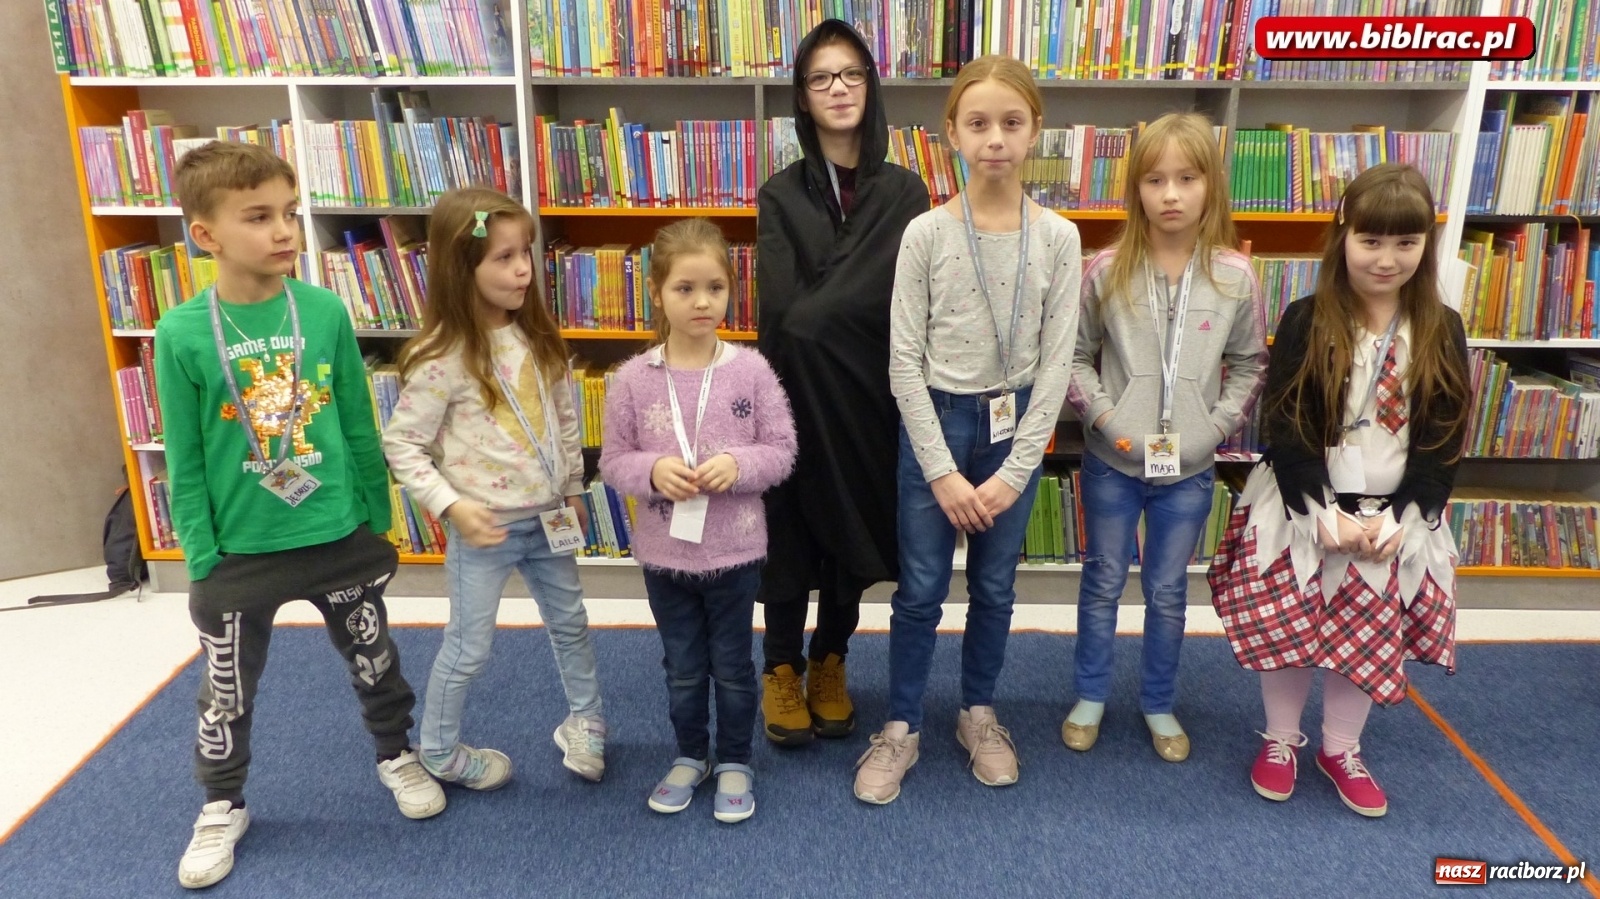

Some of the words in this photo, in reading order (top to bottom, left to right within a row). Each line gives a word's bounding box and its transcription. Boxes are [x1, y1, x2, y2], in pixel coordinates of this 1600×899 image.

[47, 0, 59, 24] LA
[52, 30, 66, 66] 8-11
[190, 17, 205, 61] PADDINGTON
[226, 338, 267, 360] GAME
[1150, 463, 1176, 475] MAJA
[551, 535, 580, 548] LAILA
[356, 649, 391, 687] 25
